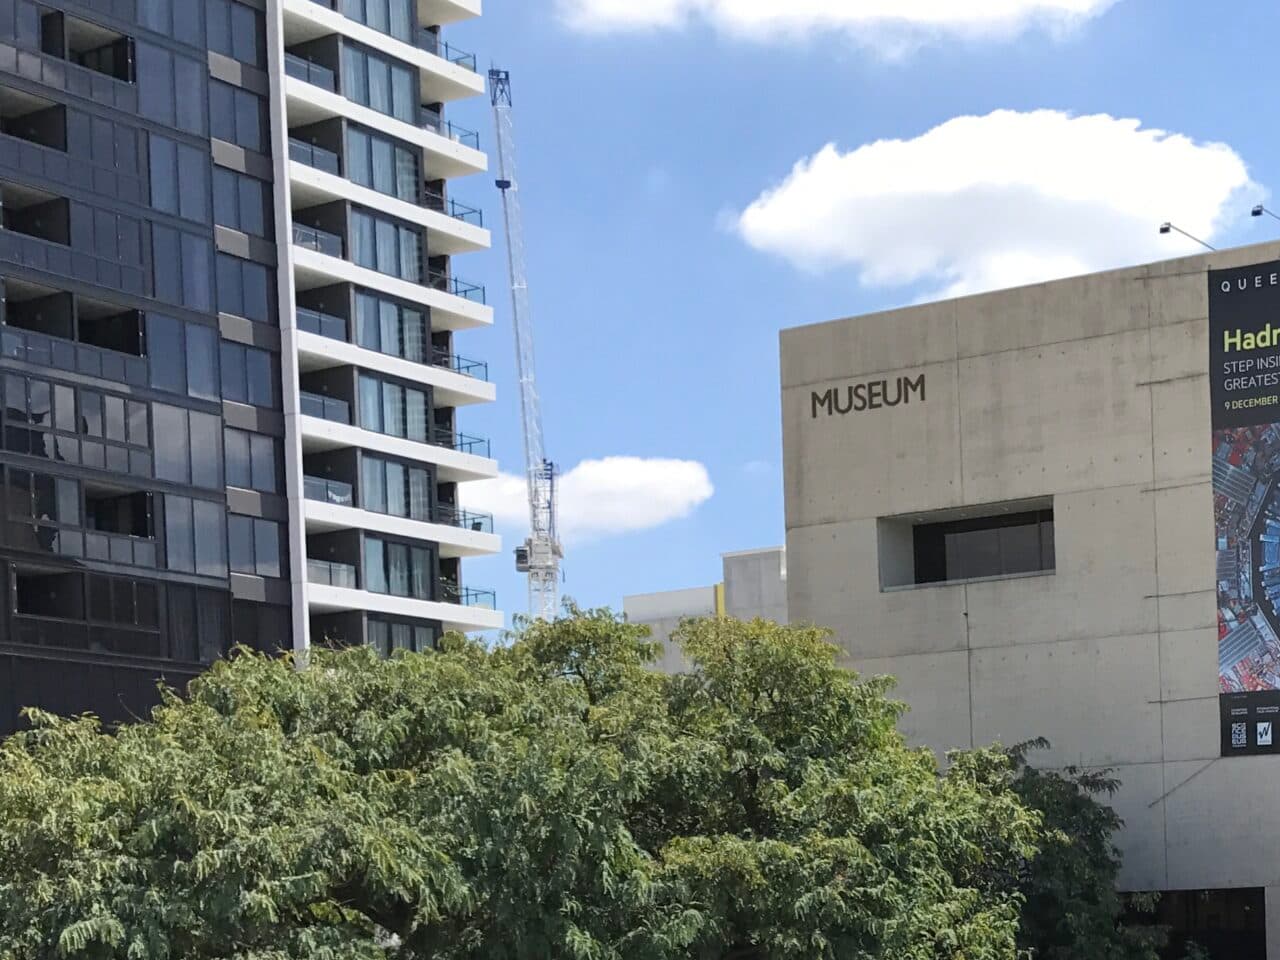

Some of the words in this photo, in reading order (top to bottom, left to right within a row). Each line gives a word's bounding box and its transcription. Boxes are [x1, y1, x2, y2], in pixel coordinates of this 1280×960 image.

[1223, 359, 1254, 375] STEP
[811, 374, 926, 419] MUSEUM
[1224, 401, 1231, 411] 9
[1231, 395, 1279, 410] DECEMBER
